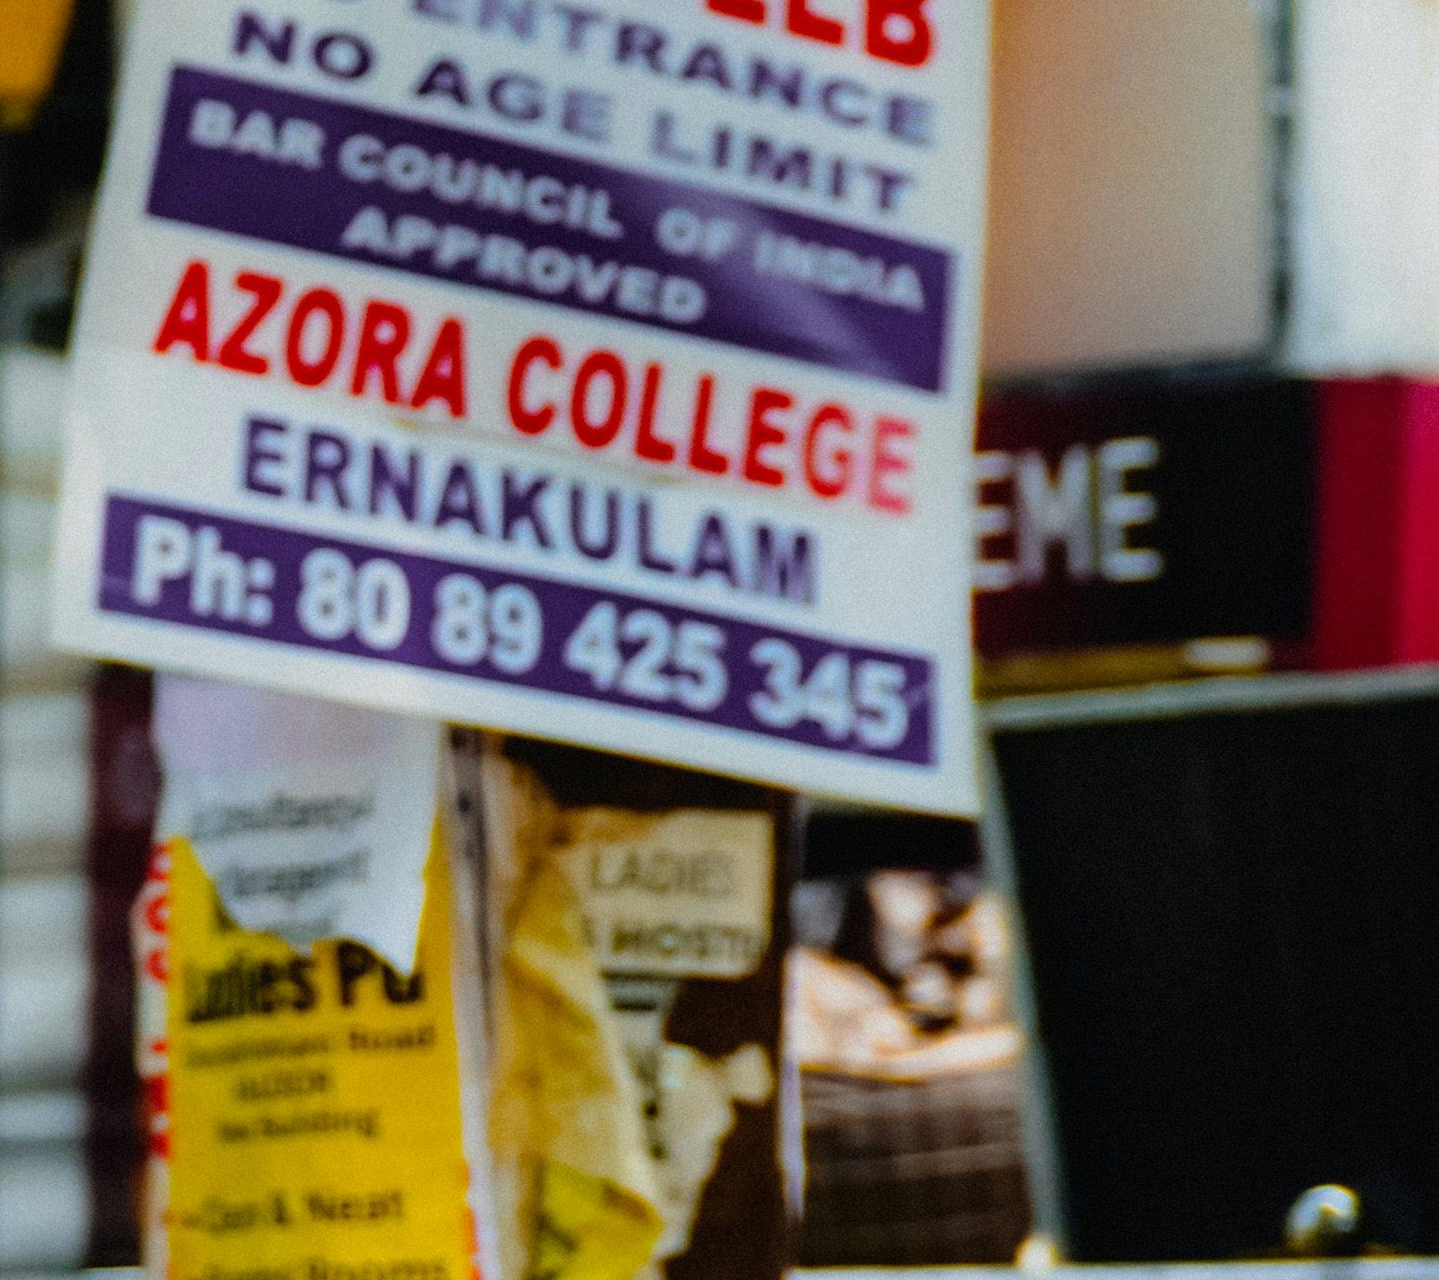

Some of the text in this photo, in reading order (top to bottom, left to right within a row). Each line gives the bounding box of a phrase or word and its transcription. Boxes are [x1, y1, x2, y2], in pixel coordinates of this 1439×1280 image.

[188, 94, 929, 313] BAR COUNCIL OF INDIA
[231, 9, 919, 216] NO AGE LIMIT
[341, 205, 710, 323] APPROVED
[151, 259, 919, 516] AZORA COLLEGE
[239, 413, 820, 607] ERNAKULAM
[131, 514, 911, 751] Ph: 80 89 425 345
